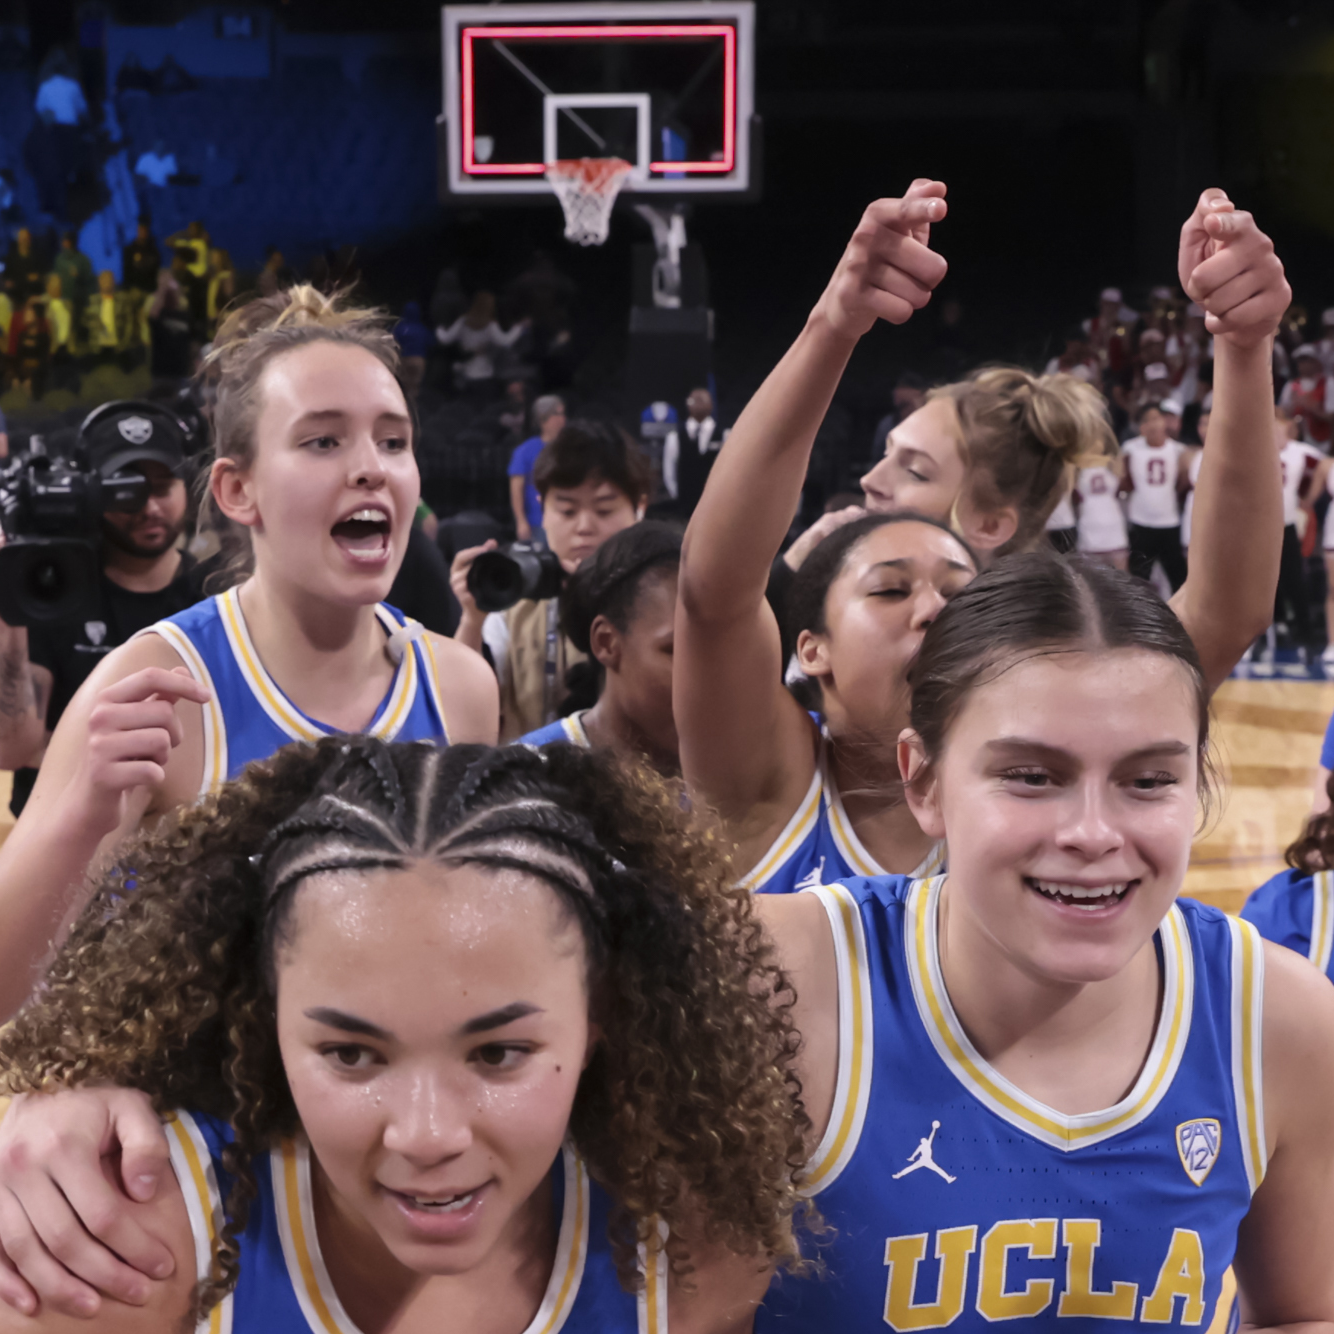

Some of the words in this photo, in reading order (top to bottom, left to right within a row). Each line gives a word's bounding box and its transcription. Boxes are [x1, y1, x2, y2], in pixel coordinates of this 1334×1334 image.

[1180, 1123, 1218, 1160] PAC
[1189, 1146, 1209, 1171] 12
[883, 1217, 1206, 1333] UCLA
